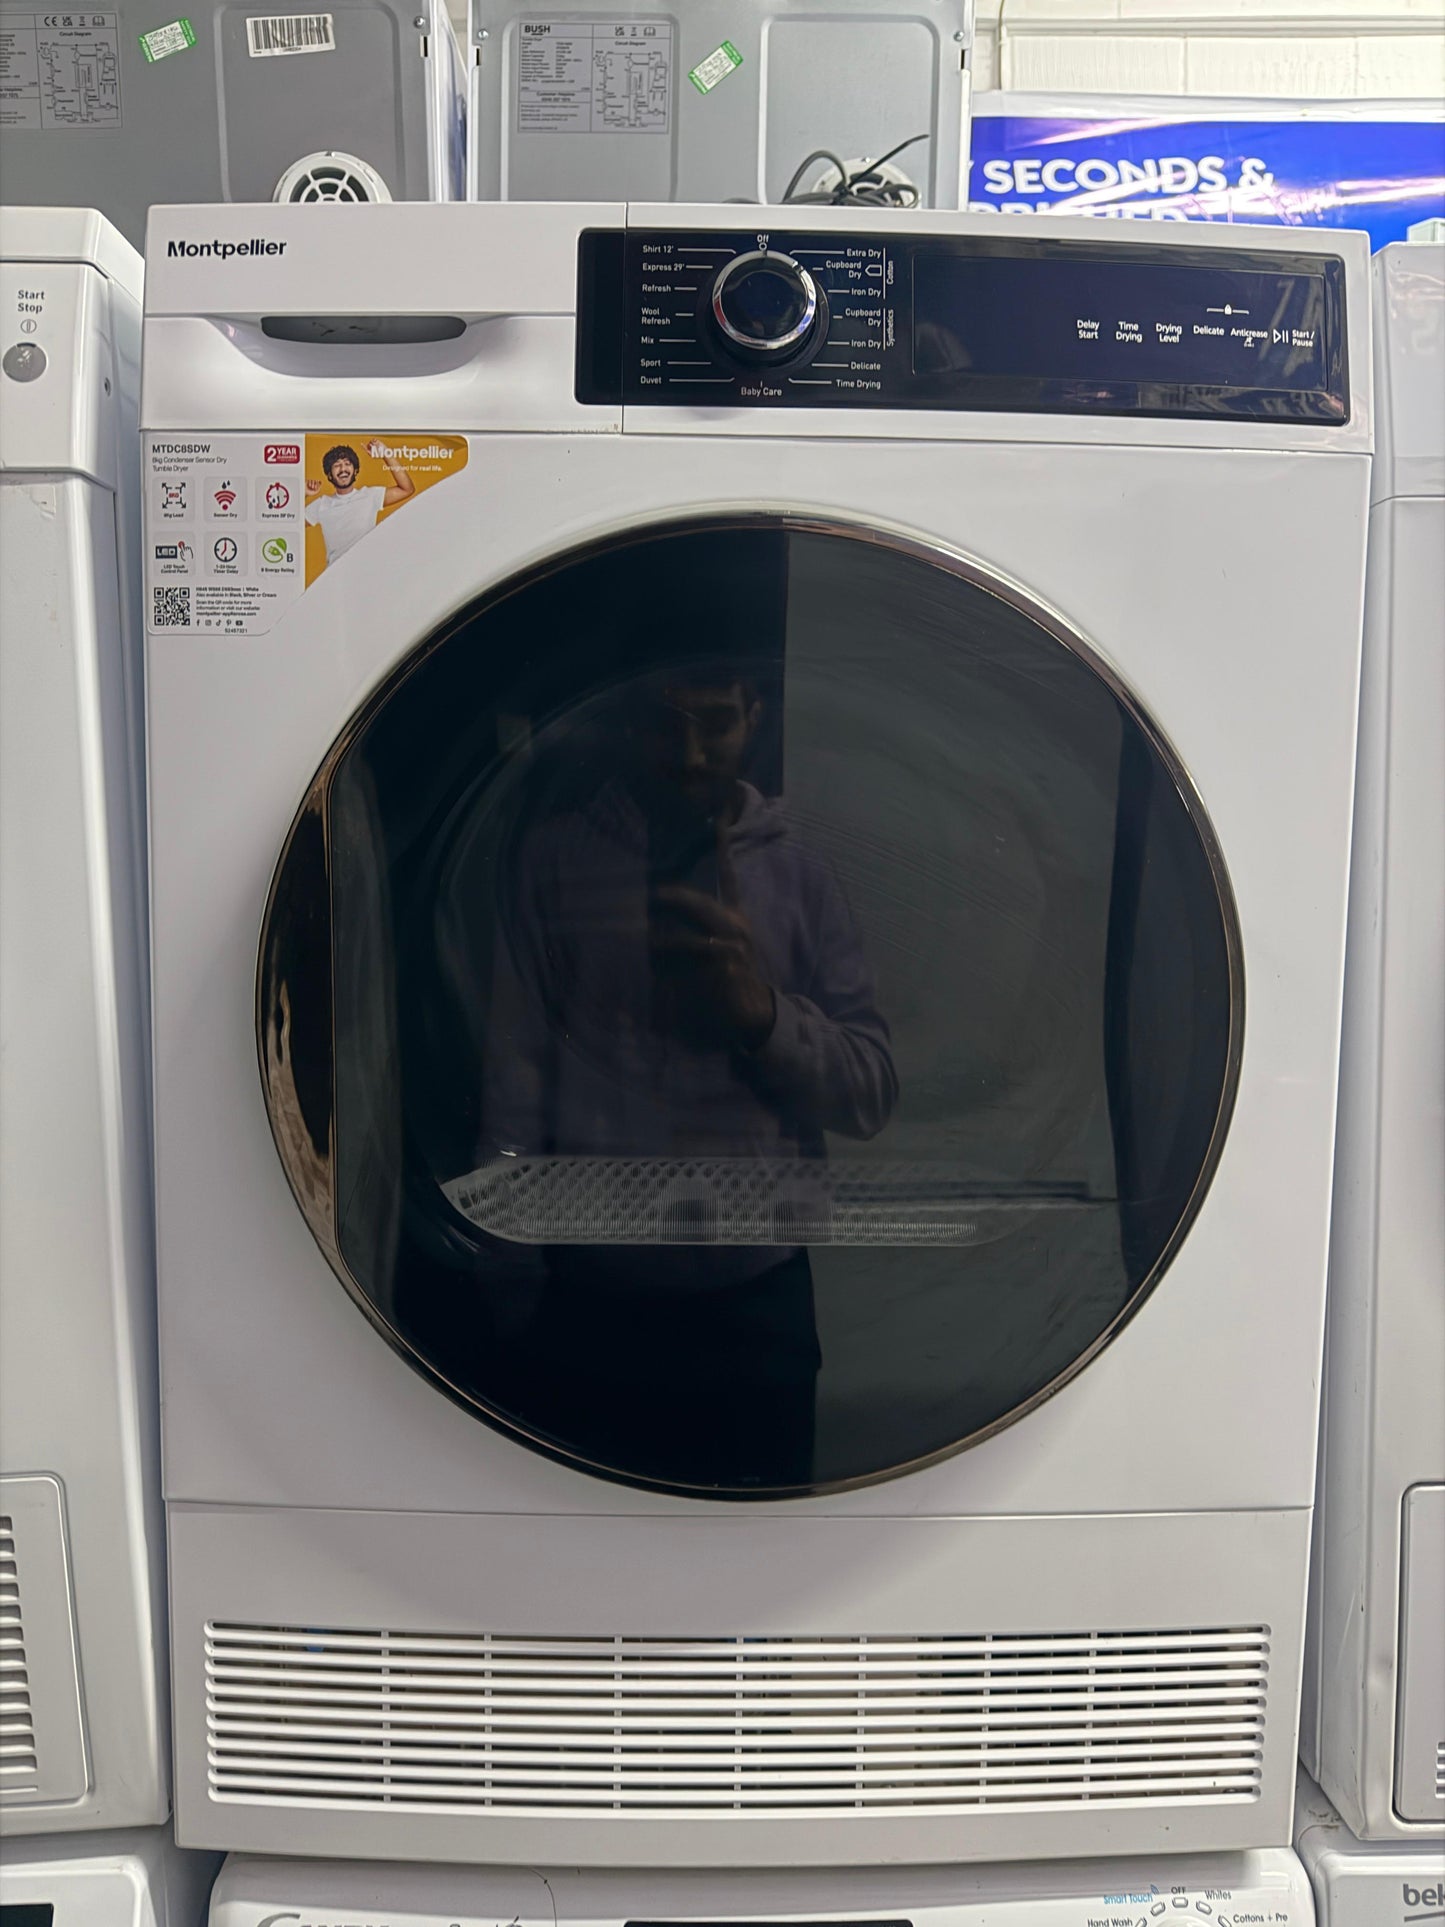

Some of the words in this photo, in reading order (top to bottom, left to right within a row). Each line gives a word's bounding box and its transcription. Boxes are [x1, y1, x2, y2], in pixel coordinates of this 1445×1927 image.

[524, 25, 551, 34] BUSH
[983, 156, 1228, 194] SECONDS
[757, 234, 769, 243] Off
[167, 239, 287, 260] Montpellier
[642, 245, 662, 253] Shirt
[846, 248, 867, 257] Extra
[868, 249, 881, 258] Dry
[642, 263, 672, 272] Express
[826, 260, 862, 269] Cupboard
[848, 270, 862, 279] Dry
[886, 260, 894, 285] Cotton
[642, 284, 671, 292] Refresh
[868, 288, 881, 298] Dry
[18, 289, 45, 300] Start
[18, 302, 43, 314] Stop
[641, 307, 660, 316] Wool
[845, 307, 881, 317] Cupboard
[641, 317, 671, 325] Refresh
[868, 318, 881, 327] Dry
[1077, 319, 1100, 331] Delay
[1118, 321, 1139, 331] Time
[886, 309, 896, 347] Synthetics
[1155, 323, 1183, 335] Drying
[1193, 325, 1225, 336] Delicate
[1230, 327, 1268, 339] Anticrease
[1078, 329, 1098, 339] Start
[1115, 331, 1143, 343] Drying
[1159, 333, 1180, 343] Level
[1292, 329, 1309, 339] Start
[641, 336, 655, 344] Mix
[868, 340, 881, 349] Dry
[1292, 338, 1314, 347] Pause
[640, 359, 661, 367] Sport
[850, 361, 881, 370] Delicate
[640, 376, 662, 384] Duvet
[836, 379, 855, 388] Time
[856, 380, 881, 389] Drying
[741, 387, 762, 397] Baby
[763, 387, 782, 396] Care
[152, 444, 211, 453] MTDC8SDW
[371, 445, 454, 461] Montpellier
[267, 447, 277, 462] 2
[277, 447, 297, 456] YEAR
[216, 456, 227, 464] Dry
[157, 547, 175, 557] LED
[286, 553, 294, 563] B
[1103, 1894, 1127, 1904] Smart
[1129, 1892, 1154, 1904] Touch
[1204, 1889, 1232, 1900] Whites
[1087, 1918, 1109, 1927] Hand
[1110, 1918, 1133, 1927] Wash
[1233, 1913, 1265, 1923] Cottons
[1275, 1912, 1289, 1922] Pre
